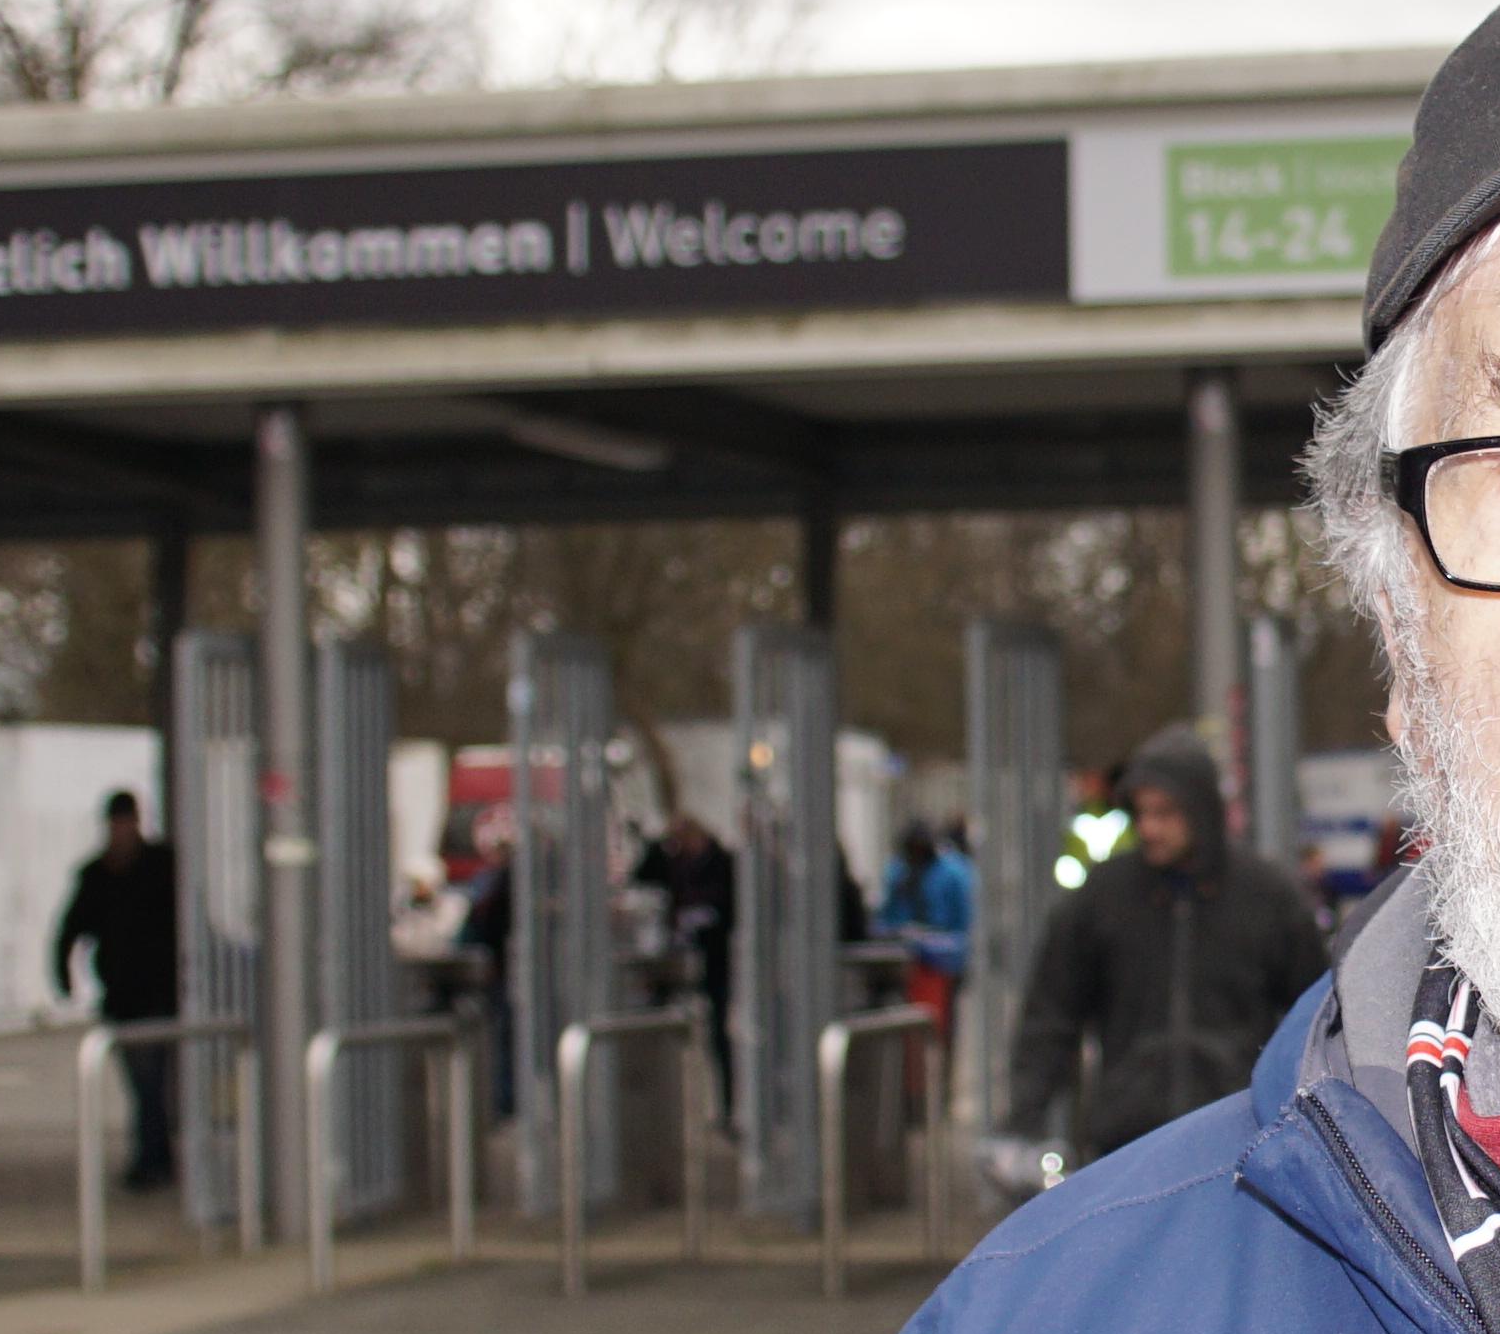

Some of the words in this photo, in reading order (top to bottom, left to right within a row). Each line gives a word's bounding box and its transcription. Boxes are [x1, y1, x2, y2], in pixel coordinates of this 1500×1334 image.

[137, 217, 554, 291] Willkommen
[604, 198, 907, 271] Welcome
[1187, 205, 1356, 267] 14-24
